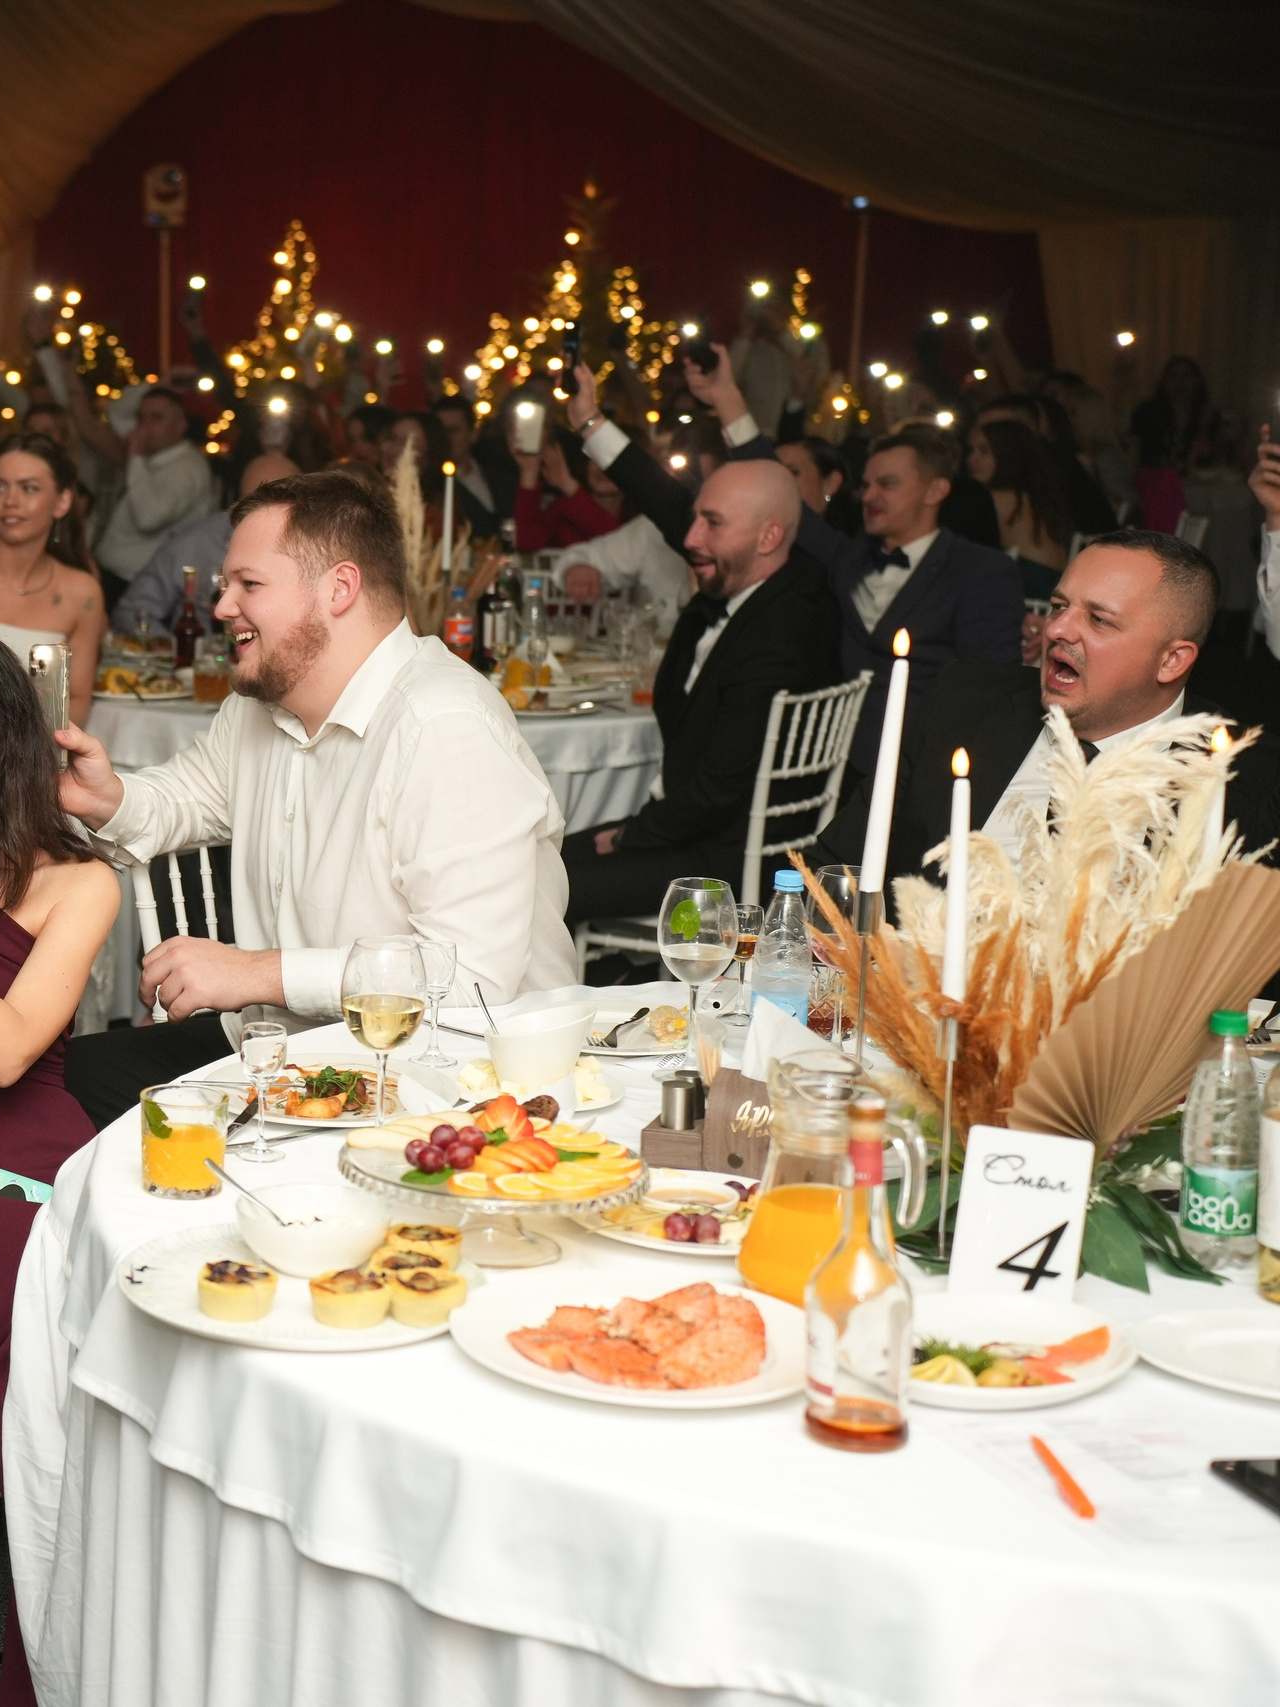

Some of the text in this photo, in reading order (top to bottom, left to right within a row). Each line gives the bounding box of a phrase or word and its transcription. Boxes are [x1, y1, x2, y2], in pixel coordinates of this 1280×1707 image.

[1188, 1188, 1239, 1213] bon
[1187, 1208, 1252, 1232] aqua
[996, 1220, 1070, 1292] 4
